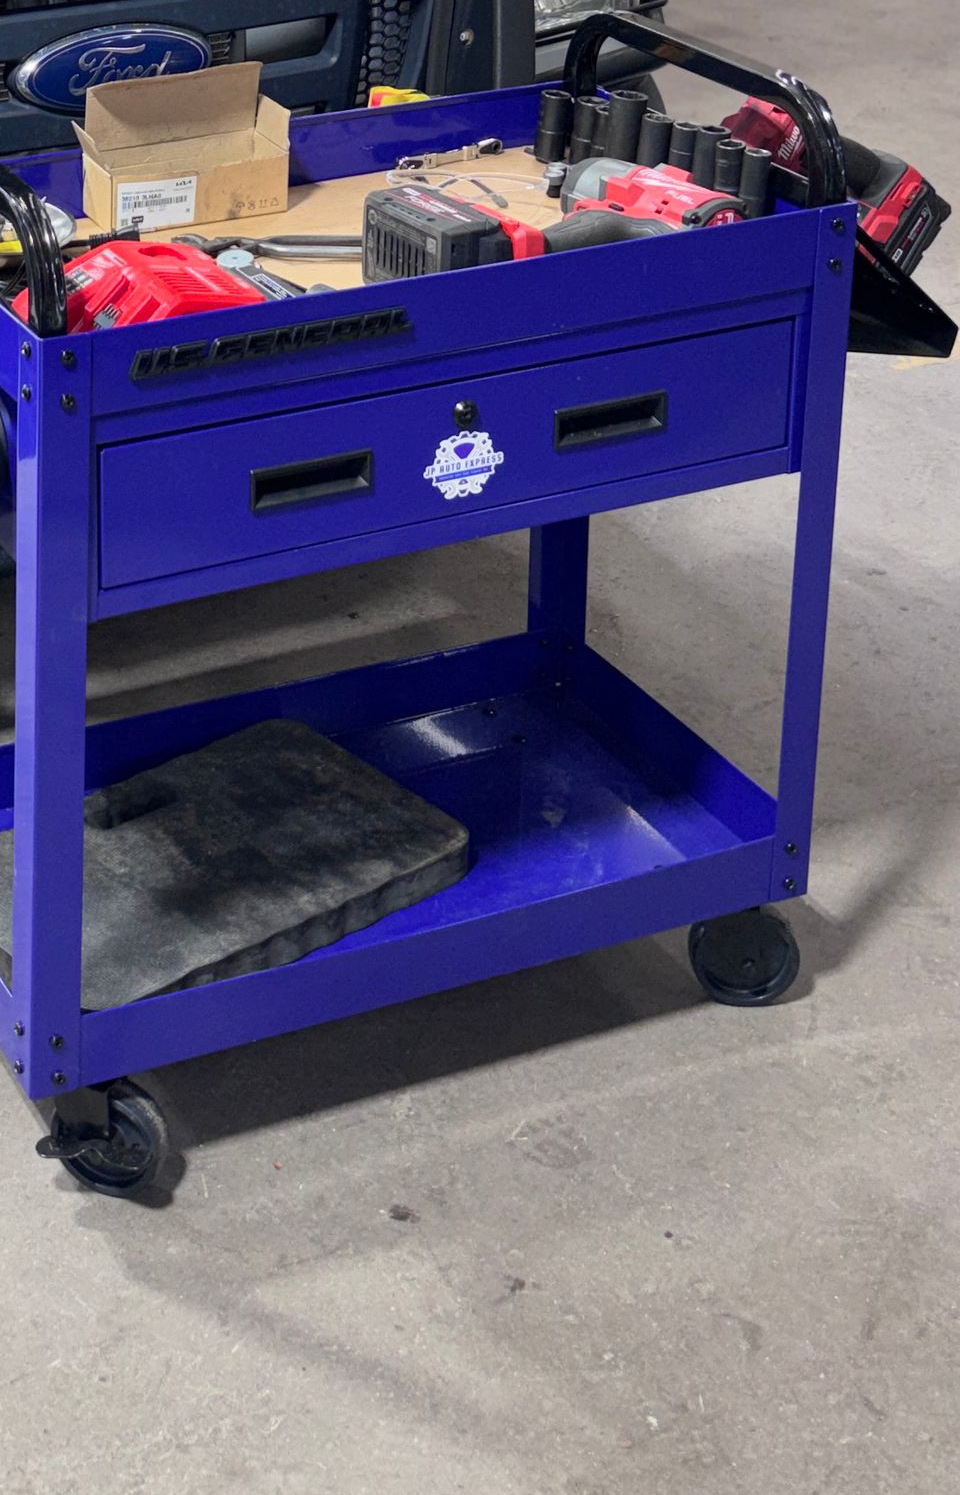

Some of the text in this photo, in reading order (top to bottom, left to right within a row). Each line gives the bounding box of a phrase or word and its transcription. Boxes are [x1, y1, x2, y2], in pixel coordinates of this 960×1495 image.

[68, 43, 171, 97] Ford
[664, 189, 695, 205] FUEL
[209, 306, 414, 362] GENERAL
[425, 467, 436, 477] JP
[439, 462, 462, 474] AUTO
[465, 453, 502, 469] EXPRESS
